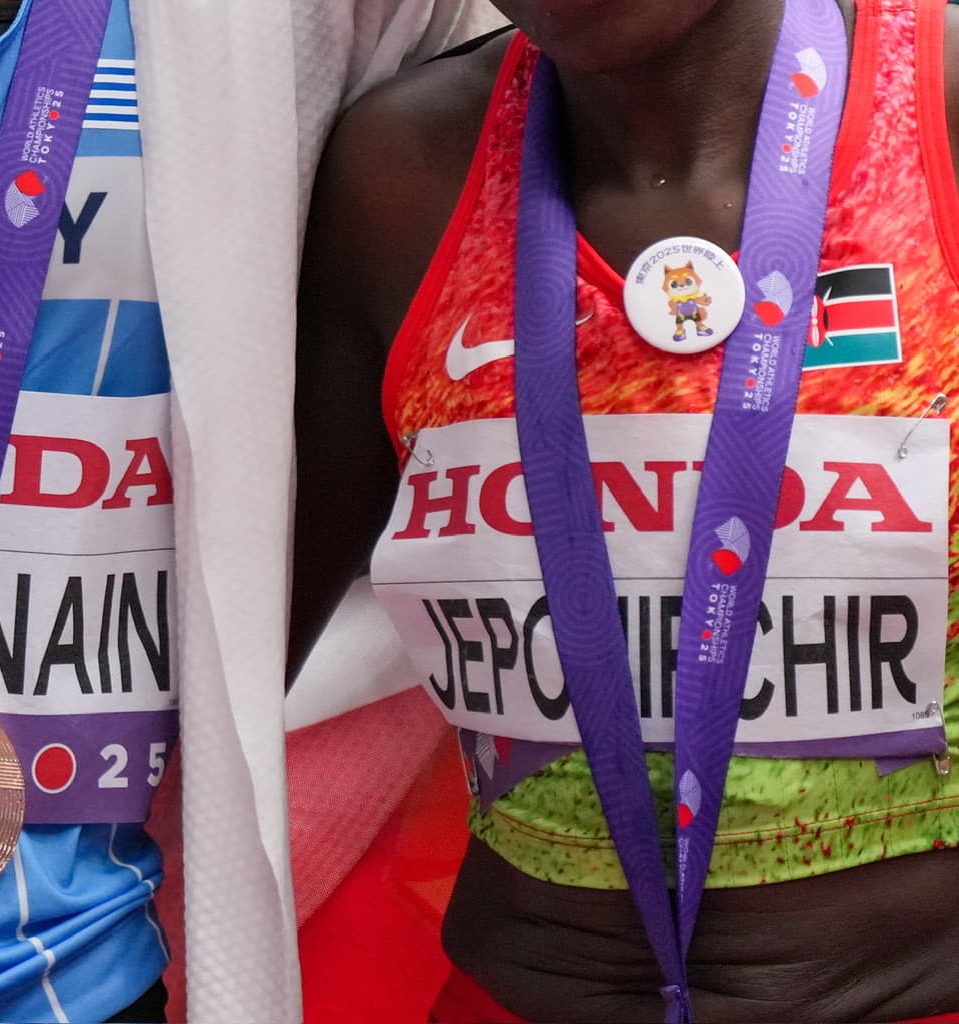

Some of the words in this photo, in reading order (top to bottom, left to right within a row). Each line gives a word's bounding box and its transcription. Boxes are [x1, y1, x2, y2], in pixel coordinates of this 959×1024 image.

[21, 132, 34, 161] WORLD
[29, 86, 46, 131] ATHLETICS
[29, 88, 54, 163] CHAMPIONSHIPS
[752, 333, 772, 411] CHAMPIONSHIPS
[770, 336, 781, 367] WORLD
[761, 368, 776, 412] ATHLETICS
[708, 584, 729, 663] CHAMPIONSHIPS
[726, 585, 737, 616] WORLD
[716, 617, 732, 664] ATHLETICS
